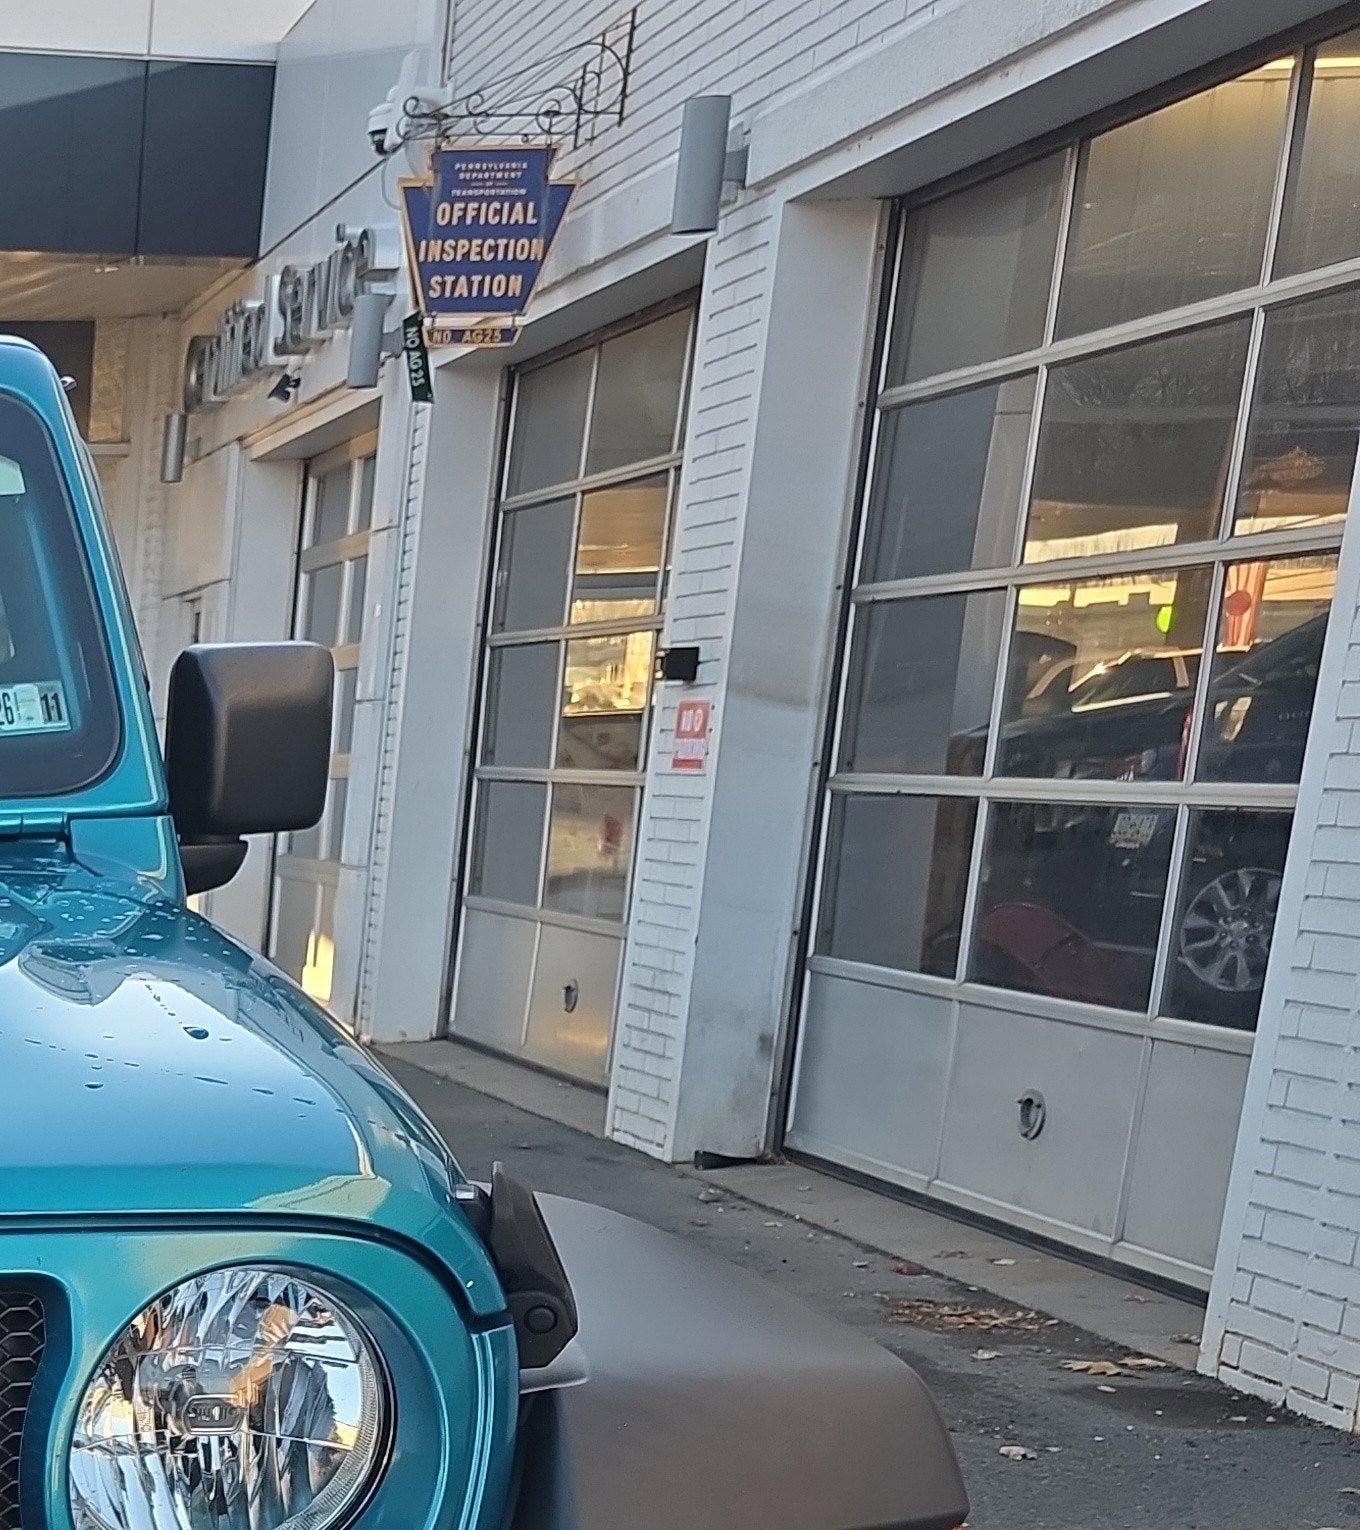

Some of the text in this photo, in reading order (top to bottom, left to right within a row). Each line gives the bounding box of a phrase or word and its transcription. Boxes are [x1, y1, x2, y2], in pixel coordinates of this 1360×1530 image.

[454, 161, 528, 171] PENNSYLVANIA
[458, 171, 523, 180] DEPARTMENT
[436, 201, 538, 226] OFFICIAL
[418, 237, 545, 263] INSPECTION
[428, 273, 523, 299] STATION
[406, 328, 421, 350] NO
[461, 328, 502, 344] AG25
[40, 691, 63, 722] 11
[681, 709, 703, 732] NO
